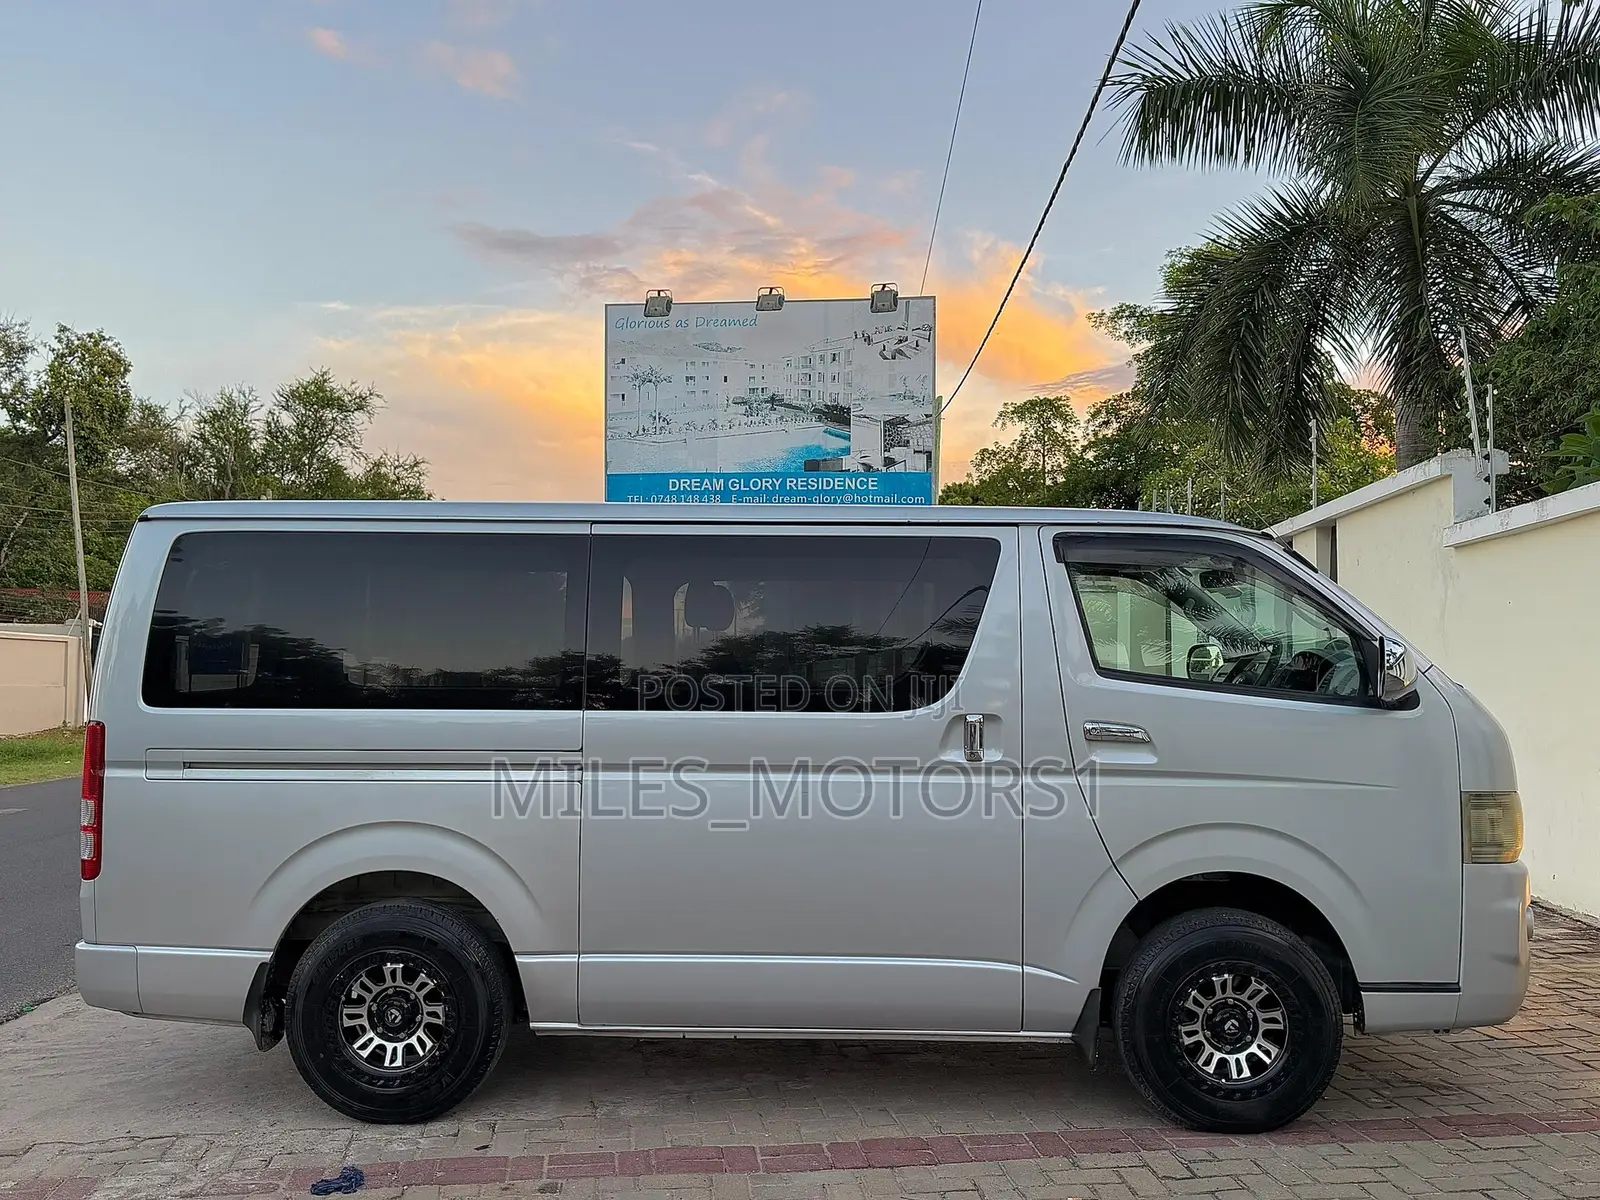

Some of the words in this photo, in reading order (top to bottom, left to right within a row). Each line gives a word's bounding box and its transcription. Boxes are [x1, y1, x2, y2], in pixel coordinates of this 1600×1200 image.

[614, 316, 670, 330] Glorious
[675, 318, 689, 328] as
[695, 314, 758, 328] Dreamed
[669, 478, 724, 491] DREAM
[728, 478, 782, 491] GLORY
[786, 477, 878, 490] RESIDENCE
[651, 494, 677, 503] 0748
[680, 494, 699, 503] 148
[701, 494, 721, 503] 438
[731, 493, 770, 503] E-mail:
[771, 493, 925, 504] dream-glory@hotmail.com
